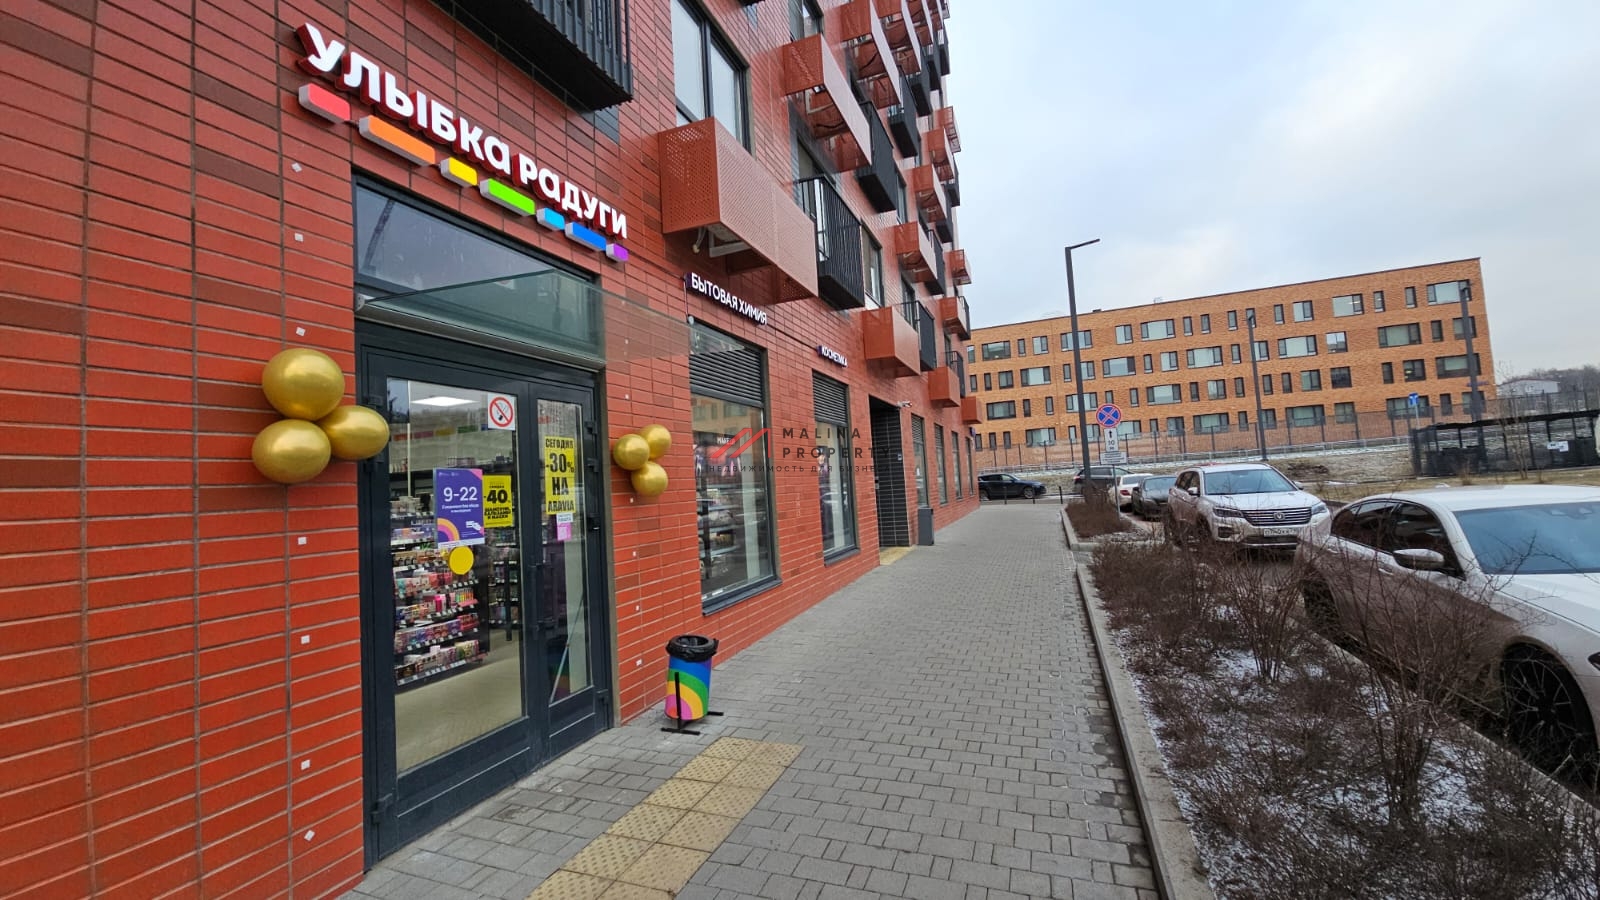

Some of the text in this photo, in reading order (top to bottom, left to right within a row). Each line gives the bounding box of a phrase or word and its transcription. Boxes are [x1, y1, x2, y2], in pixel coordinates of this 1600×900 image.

[691, 272, 767, 325] БЫТОВАЯ ХИМИЯ
[545, 438, 574, 449] СЕГОДНЯ
[443, 486, 478, 503] 9-22
[552, 477, 569, 495] НА
